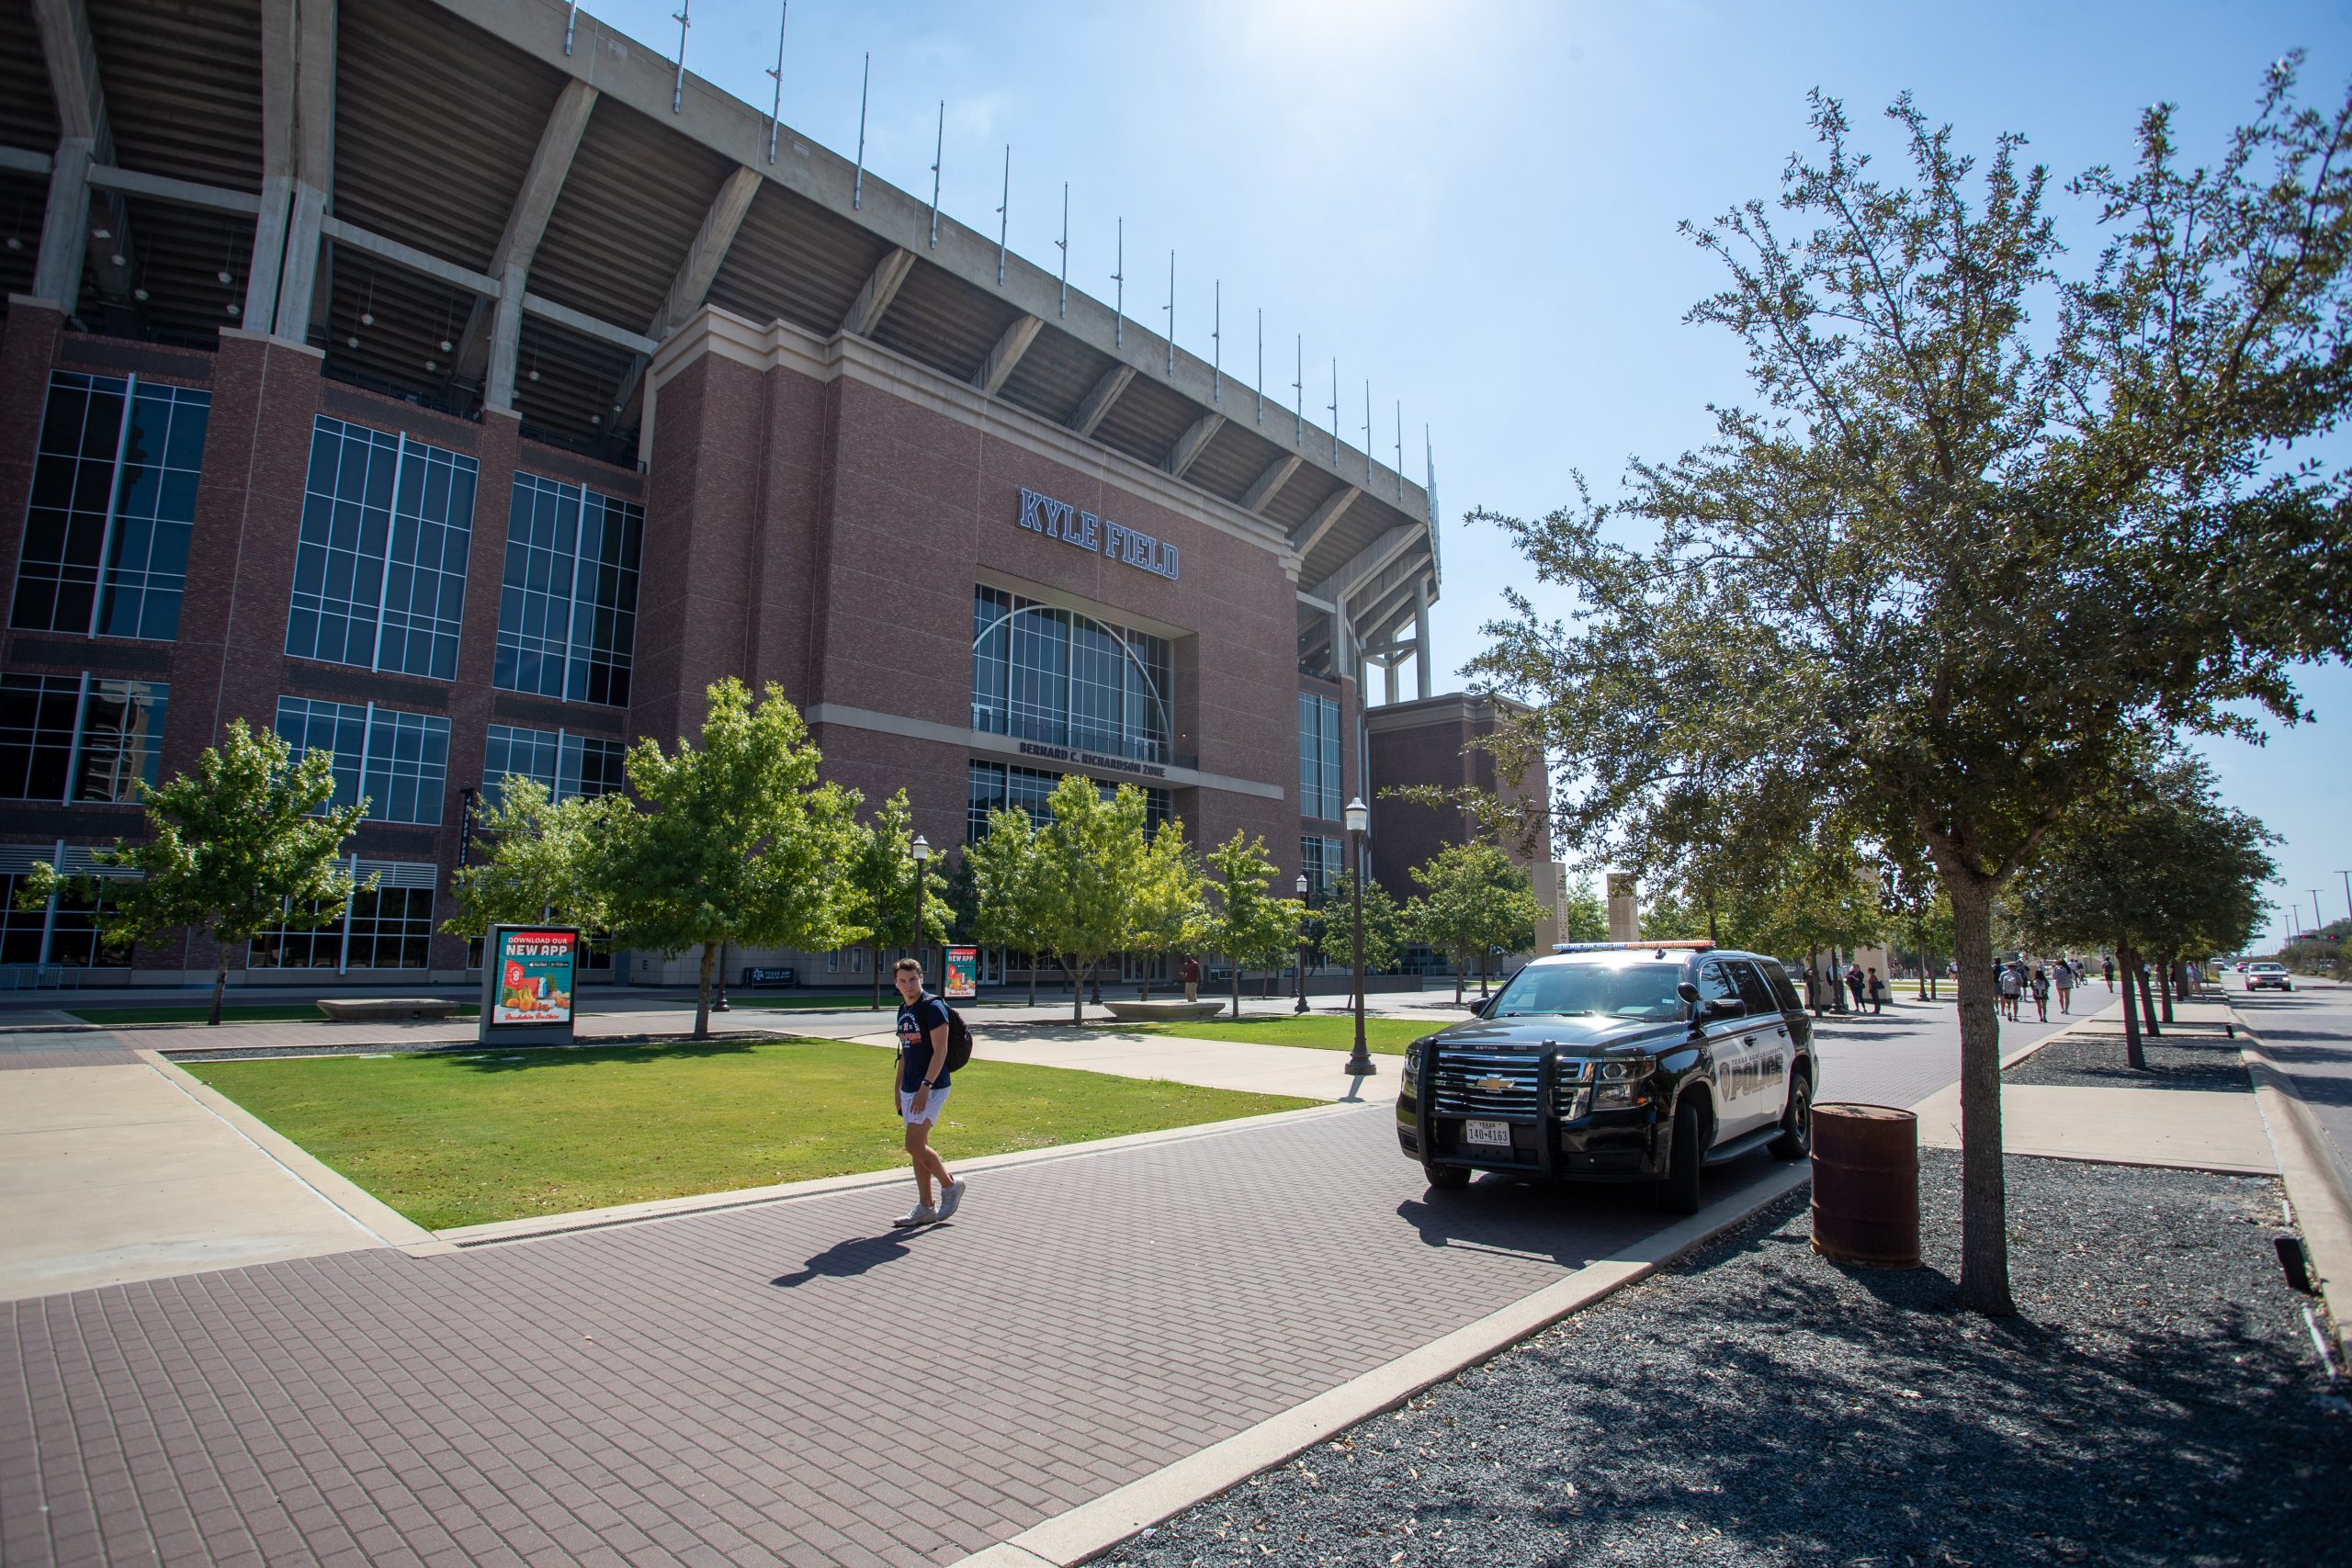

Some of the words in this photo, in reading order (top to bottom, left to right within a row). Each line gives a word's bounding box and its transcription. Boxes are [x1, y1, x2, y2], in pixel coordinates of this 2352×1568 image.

[1020, 488, 1098, 552] KYLE
[1105, 520, 1179, 581] FIELD
[1020, 741, 1068, 761] BERNARD
[1070, 750, 1080, 763] C.
[1081, 753, 1141, 773] RICHARDSON
[1143, 764, 1166, 778] ZONE
[506, 944, 538, 955] NEW
[540, 944, 568, 956] APP
[1731, 1055, 1747, 1066] TEXAS
[1759, 1046, 1783, 1058] UNIVERSITY
[1730, 1053, 1783, 1101] POLICE
